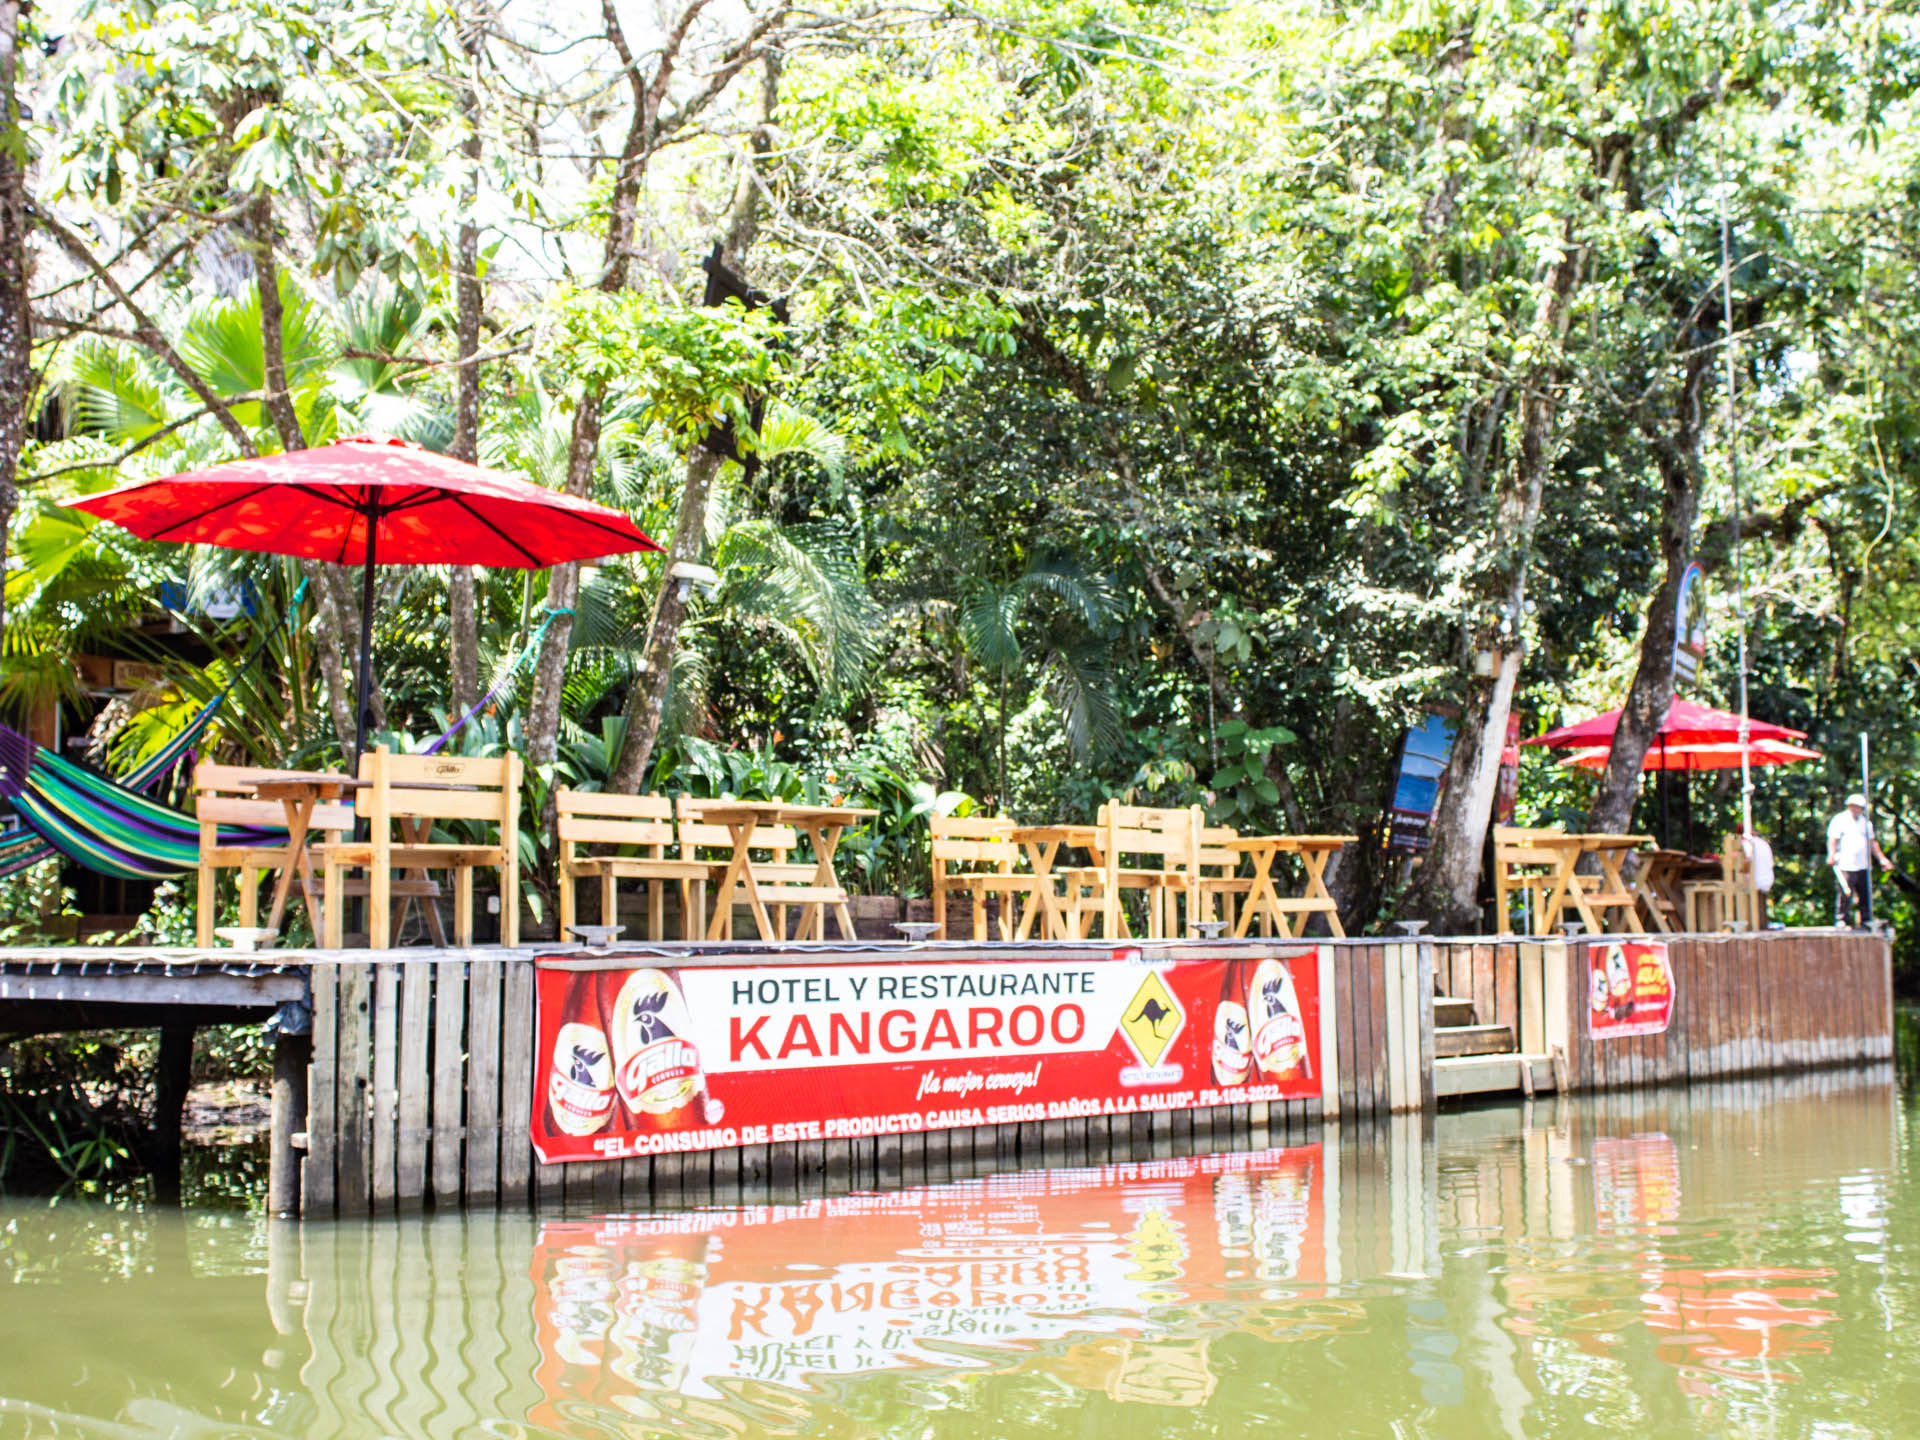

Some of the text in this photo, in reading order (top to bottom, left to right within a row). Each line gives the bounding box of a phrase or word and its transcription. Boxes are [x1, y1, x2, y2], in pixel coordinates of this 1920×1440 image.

[732, 971, 1096, 1005] HOTEL Y RESTAURANTE
[729, 1003, 1086, 1062] KANGAROO
[942, 1070, 984, 1099] mejor
[985, 1061, 1043, 1096] cerveza!
[634, 1127, 737, 1154] CONSUMO
[741, 1125, 769, 1144] DE
[772, 1121, 821, 1142] ESTE
[825, 1112, 922, 1138] PRODUCTO
[926, 1107, 985, 1129] CAUSA
[986, 1103, 1045, 1124] SERIOS
[1048, 1097, 1101, 1117] DAÑOS
[1103, 1097, 1115, 1114] A
[1118, 1095, 1139, 1112] LA
